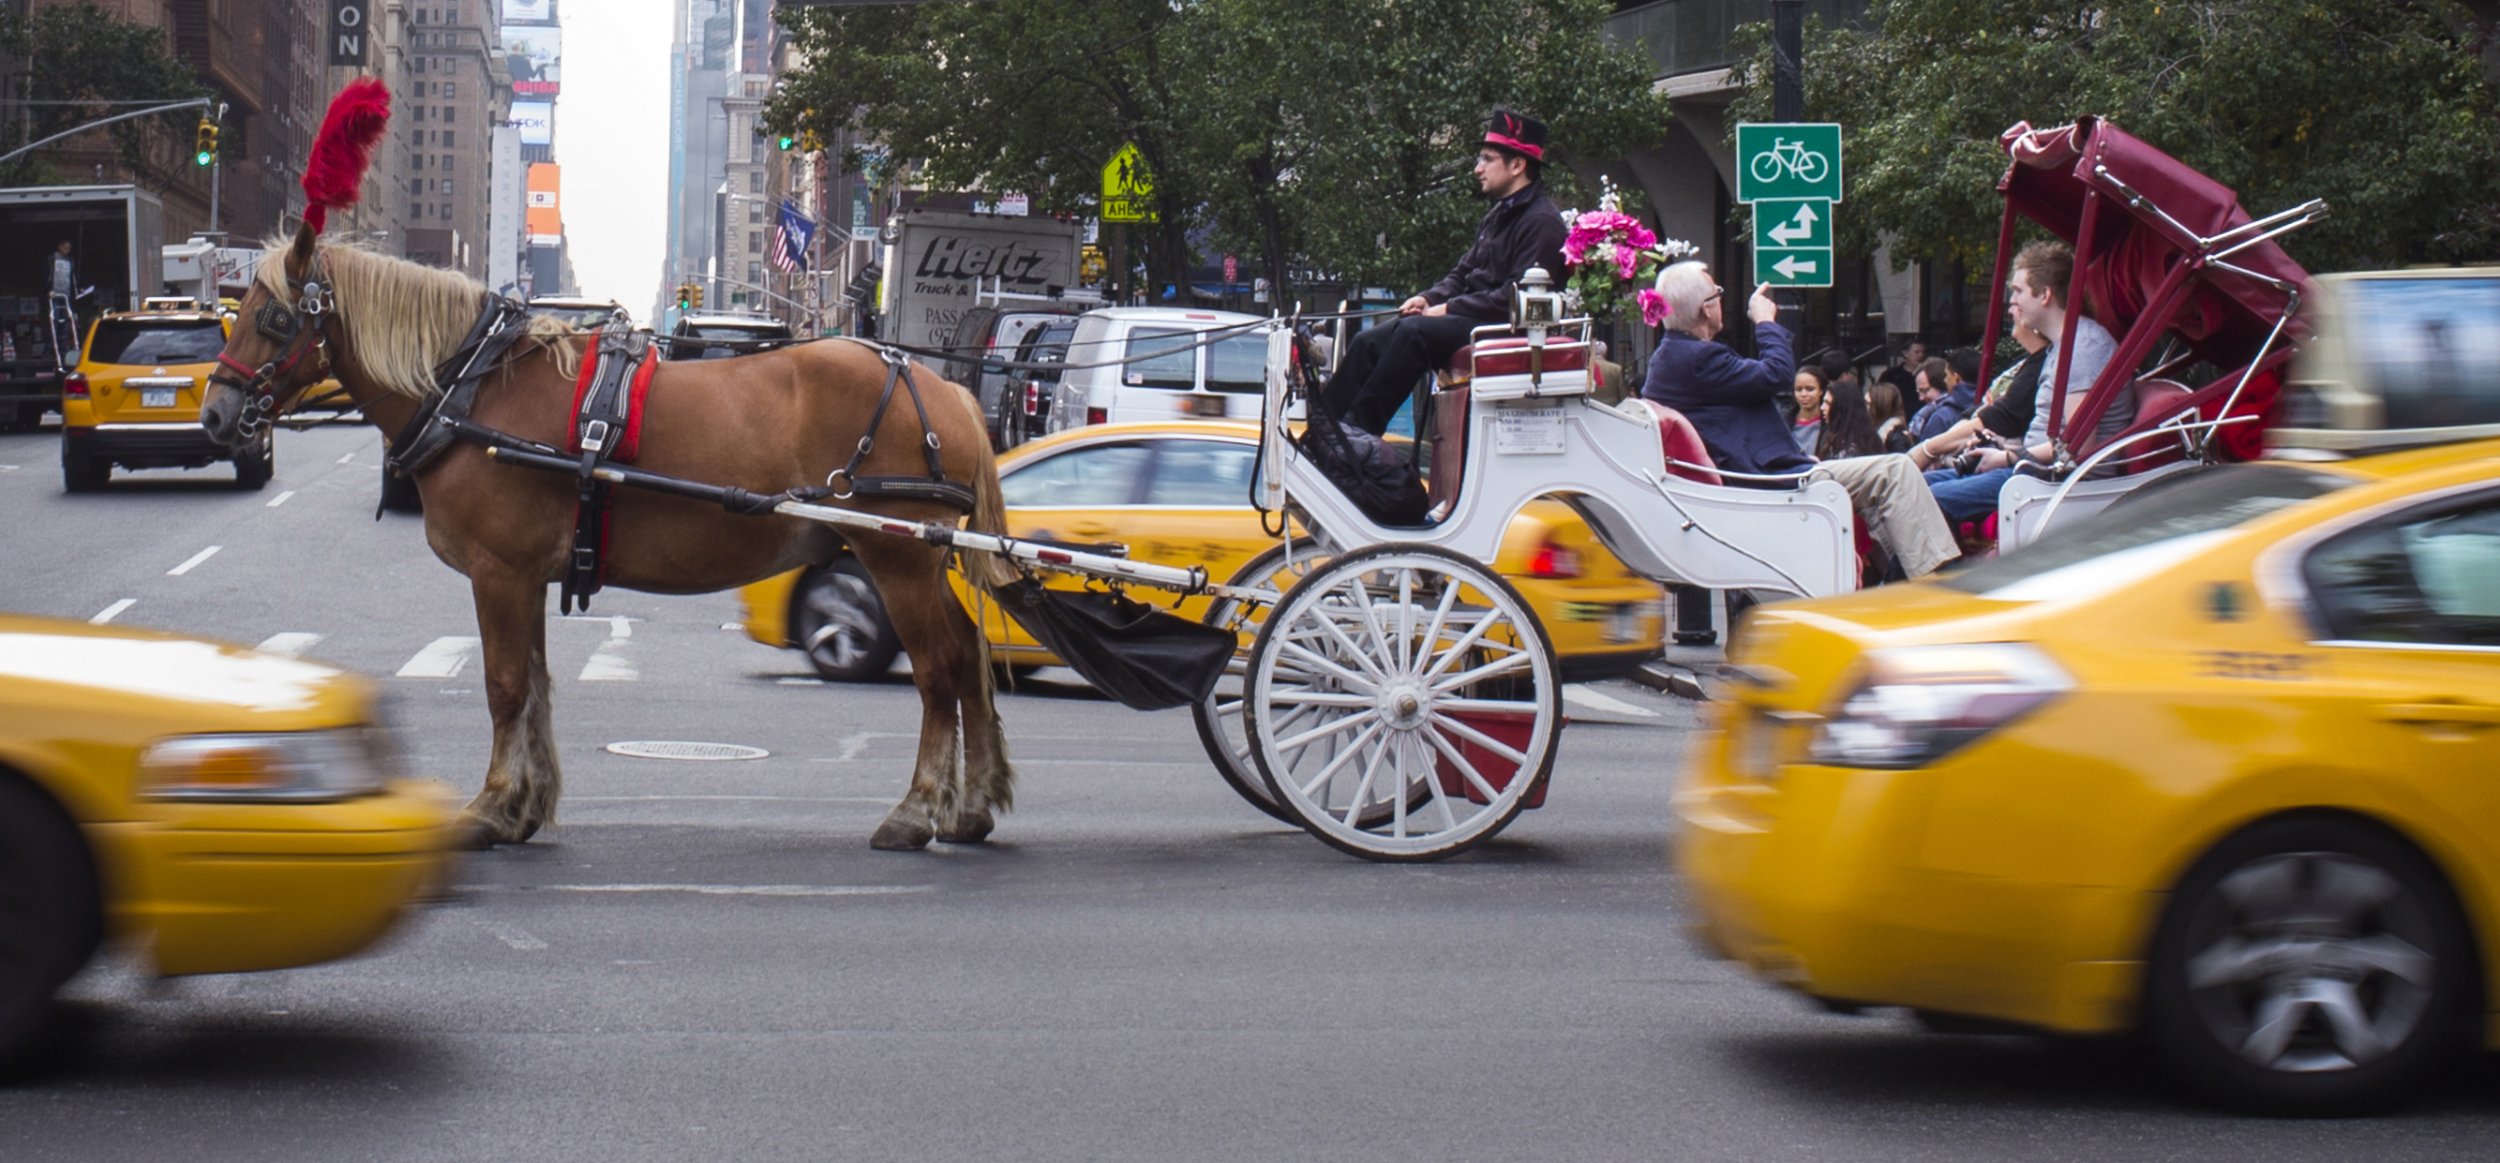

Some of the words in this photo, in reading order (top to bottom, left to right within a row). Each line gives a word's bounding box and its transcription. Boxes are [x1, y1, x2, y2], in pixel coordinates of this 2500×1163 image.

[339, 5, 360, 56] ON
[915, 235, 1061, 285] Hertz
[914, 281, 952, 296] Truck
[955, 284, 969, 296] &
